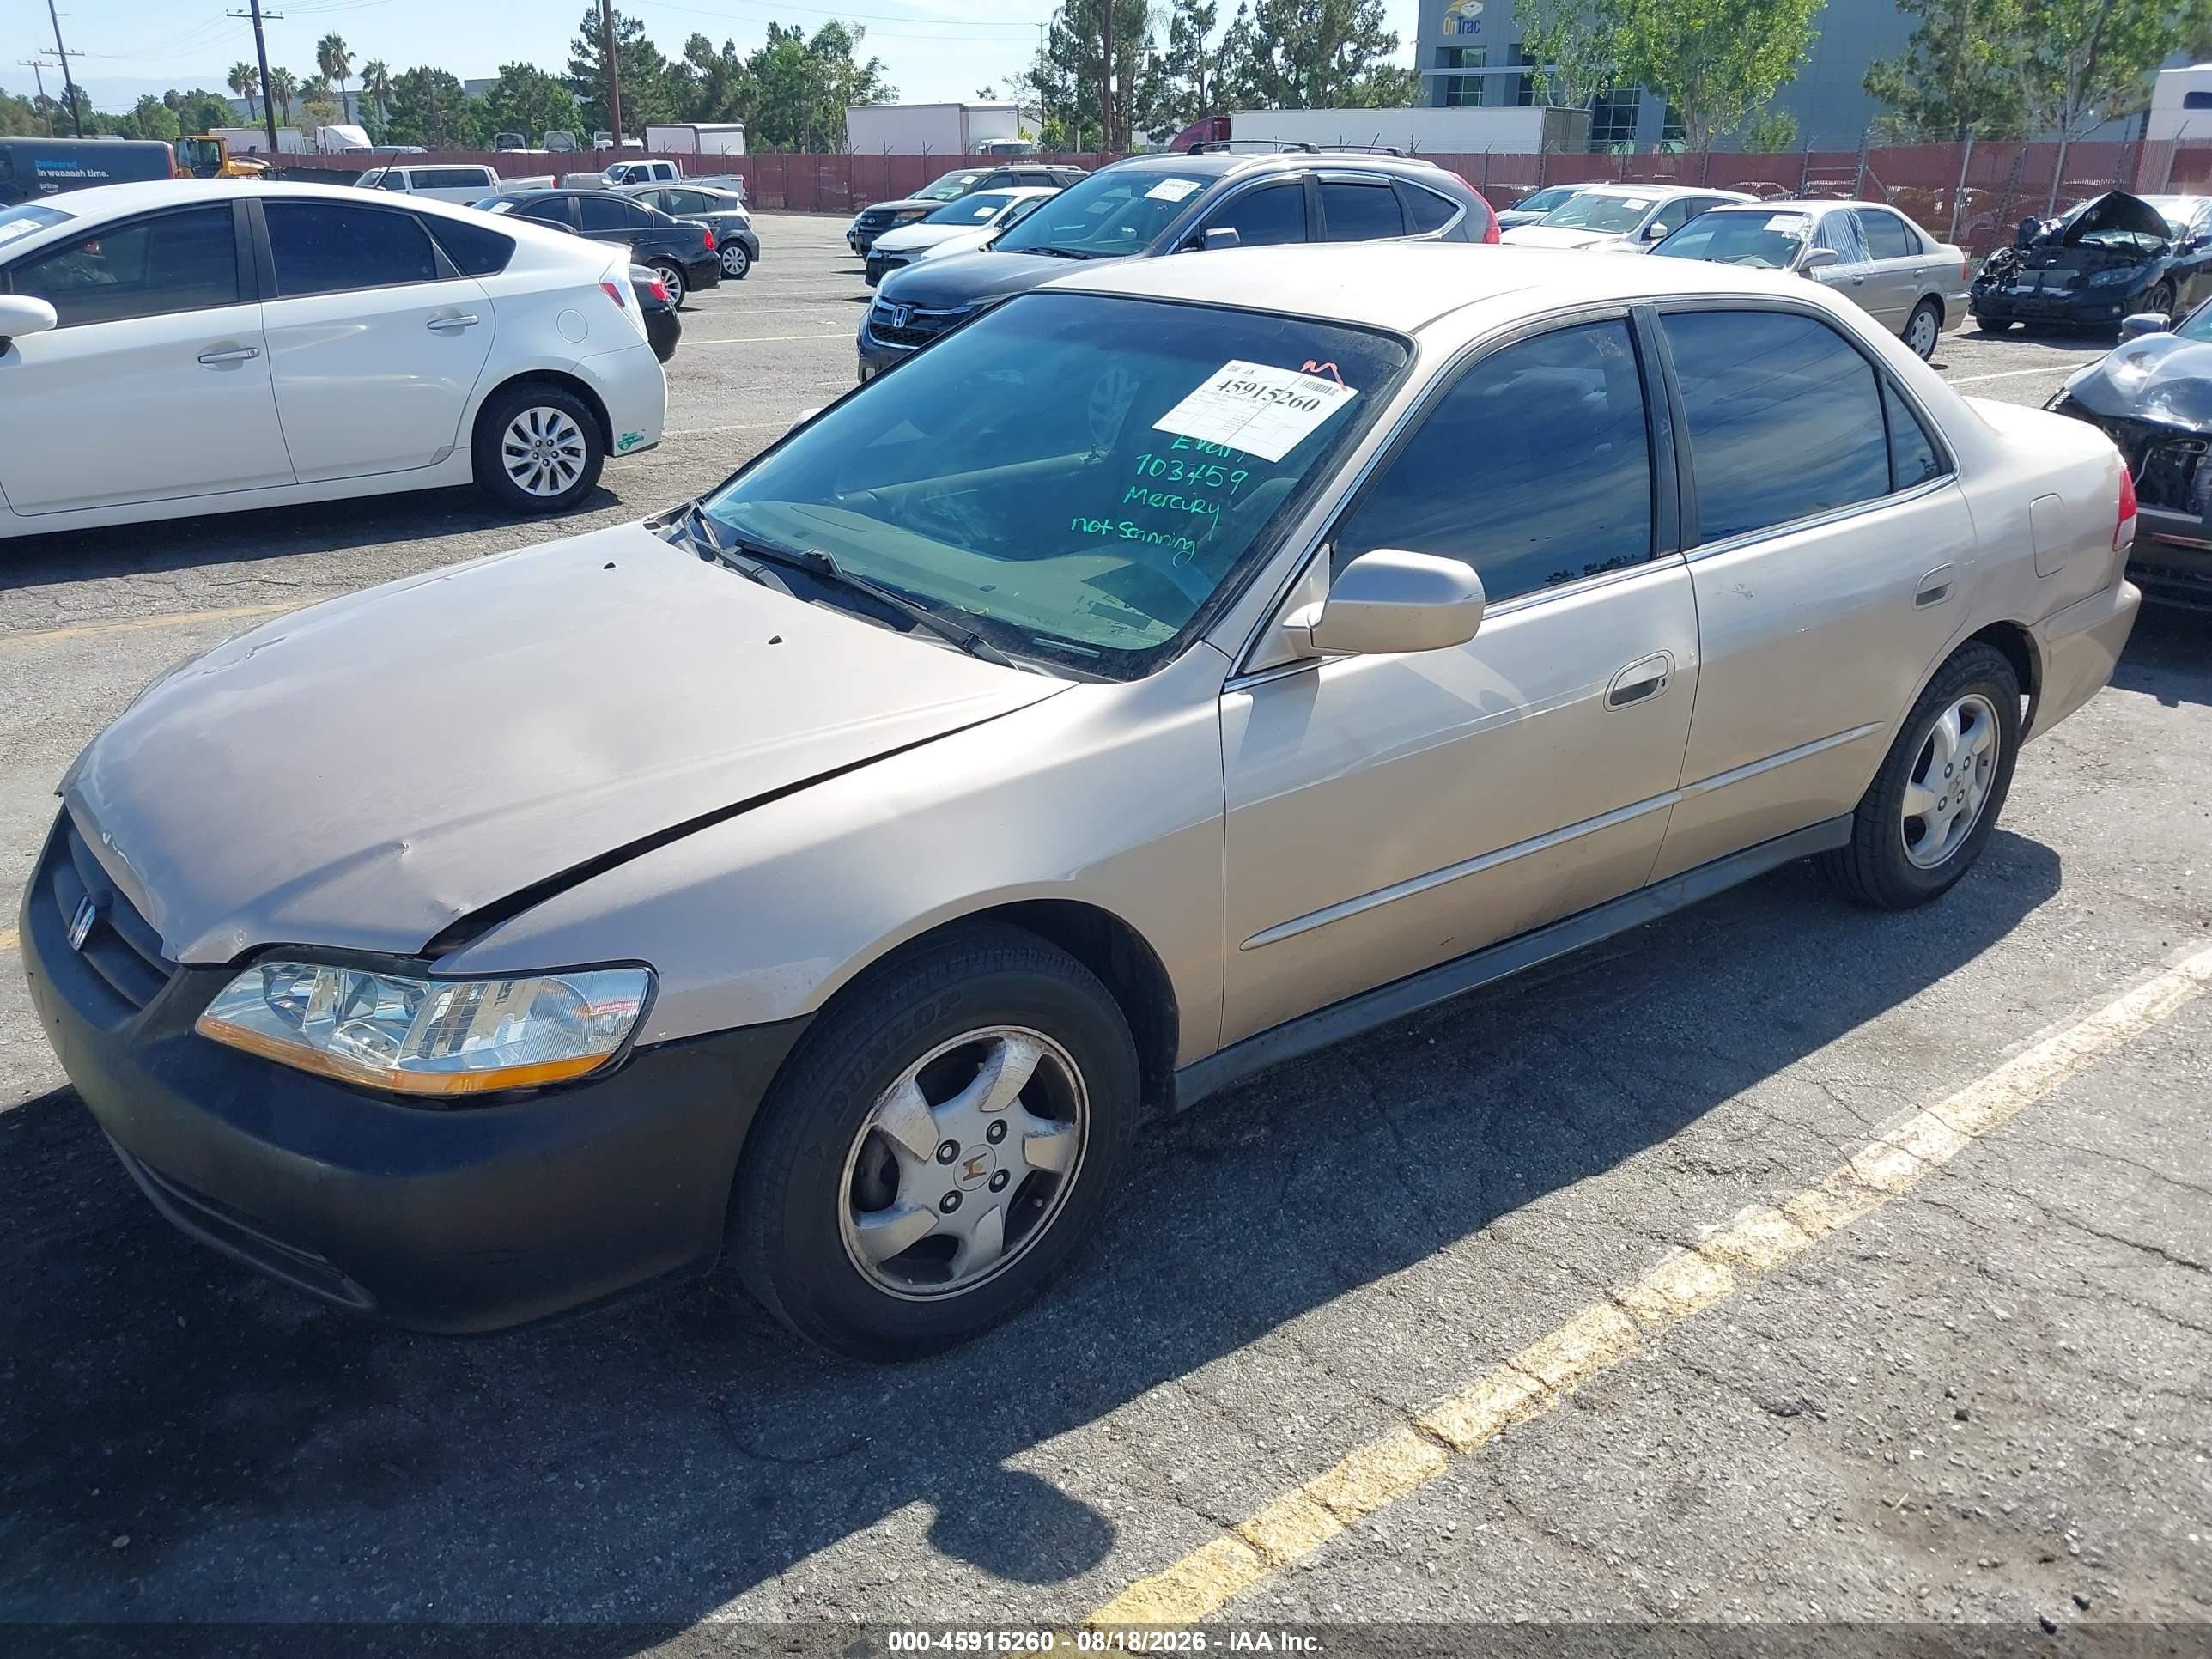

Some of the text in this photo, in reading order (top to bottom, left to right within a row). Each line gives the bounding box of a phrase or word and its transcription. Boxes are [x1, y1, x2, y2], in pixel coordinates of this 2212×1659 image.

[1443, 16, 1481, 35] OnTrac
[1216, 379, 1321, 412] 45915260
[1135, 453, 1249, 495] 103759
[1071, 517, 1114, 536] not
[826, 988, 963, 1127] DUNLOP
